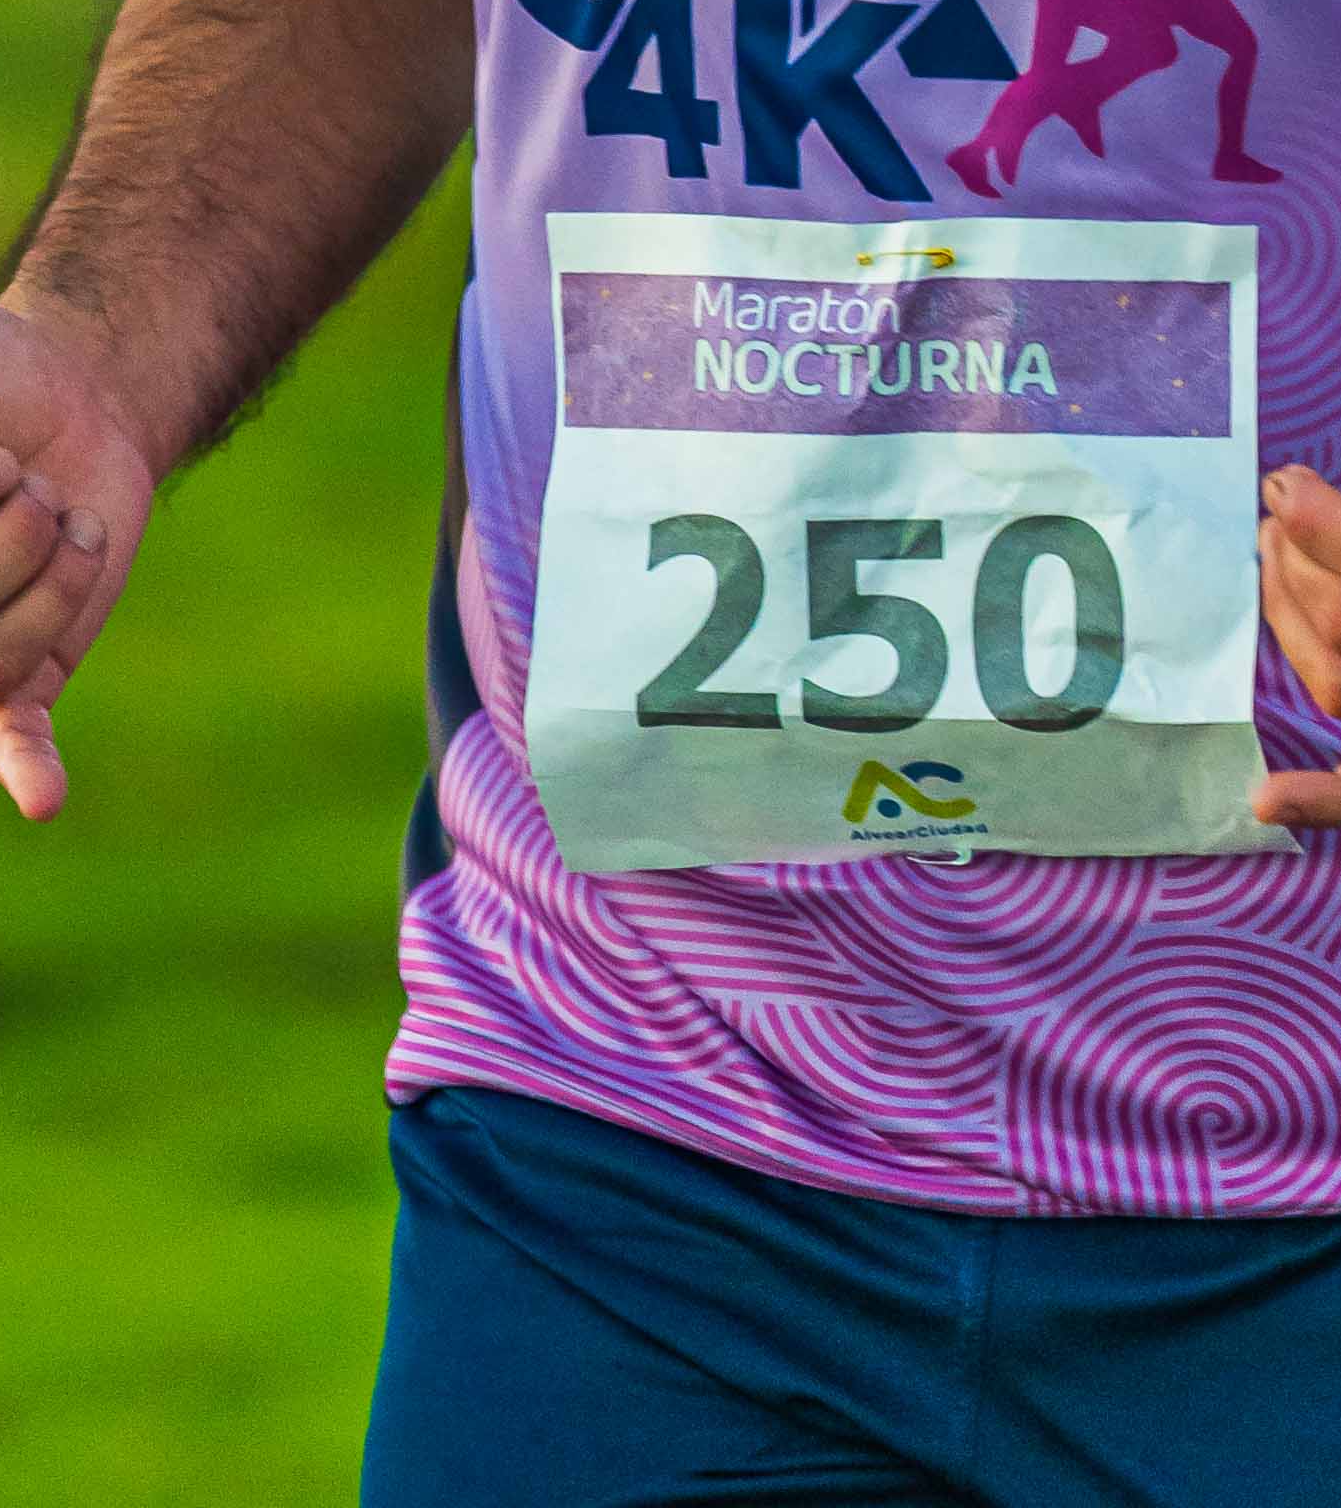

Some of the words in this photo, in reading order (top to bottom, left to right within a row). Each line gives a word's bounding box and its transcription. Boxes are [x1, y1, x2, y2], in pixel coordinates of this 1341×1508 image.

[694, 280, 901, 335] Maratón
[694, 339, 1058, 397] NOCTURNA
[636, 513, 1125, 733] 250
